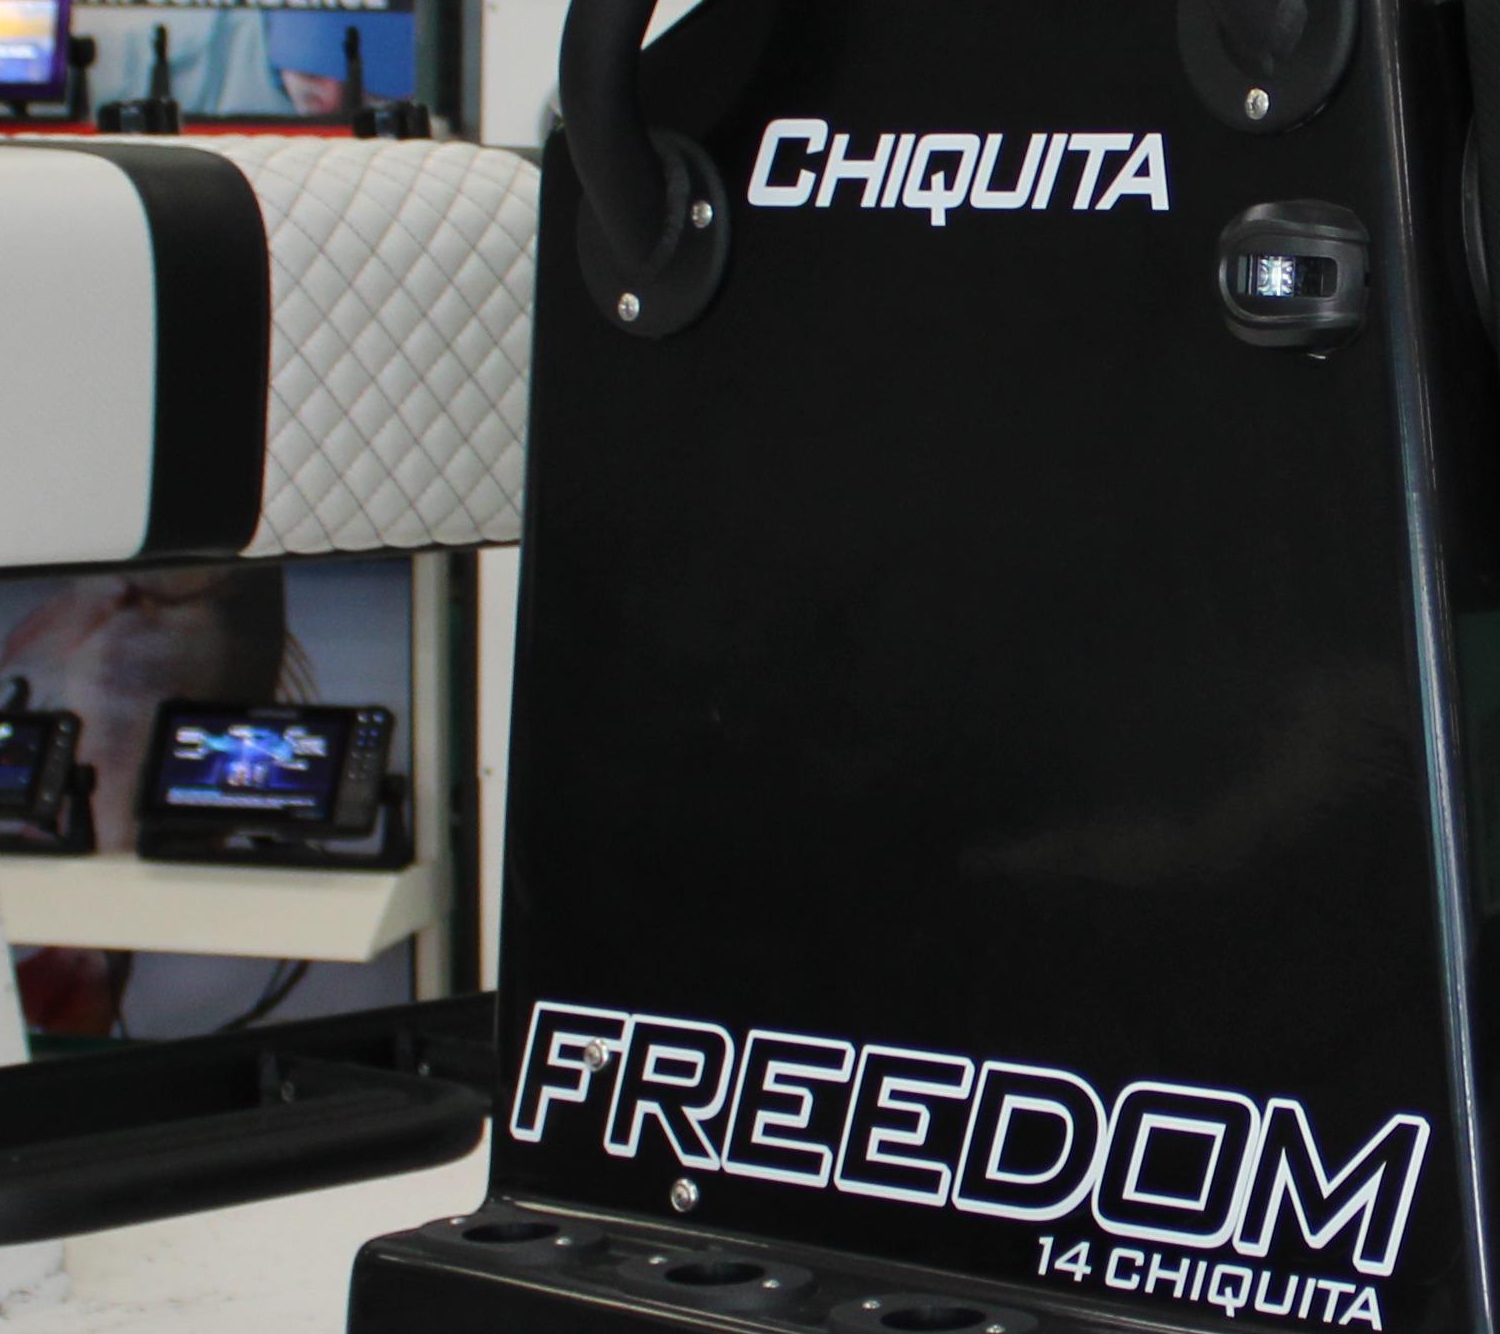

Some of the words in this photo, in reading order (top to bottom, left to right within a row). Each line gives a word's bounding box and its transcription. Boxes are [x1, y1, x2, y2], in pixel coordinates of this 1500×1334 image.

[509, 1000, 1431, 1276] FREEDOM
[1037, 1236, 1094, 1282] 14
[1104, 1248, 1385, 1332] CHIQUITA
